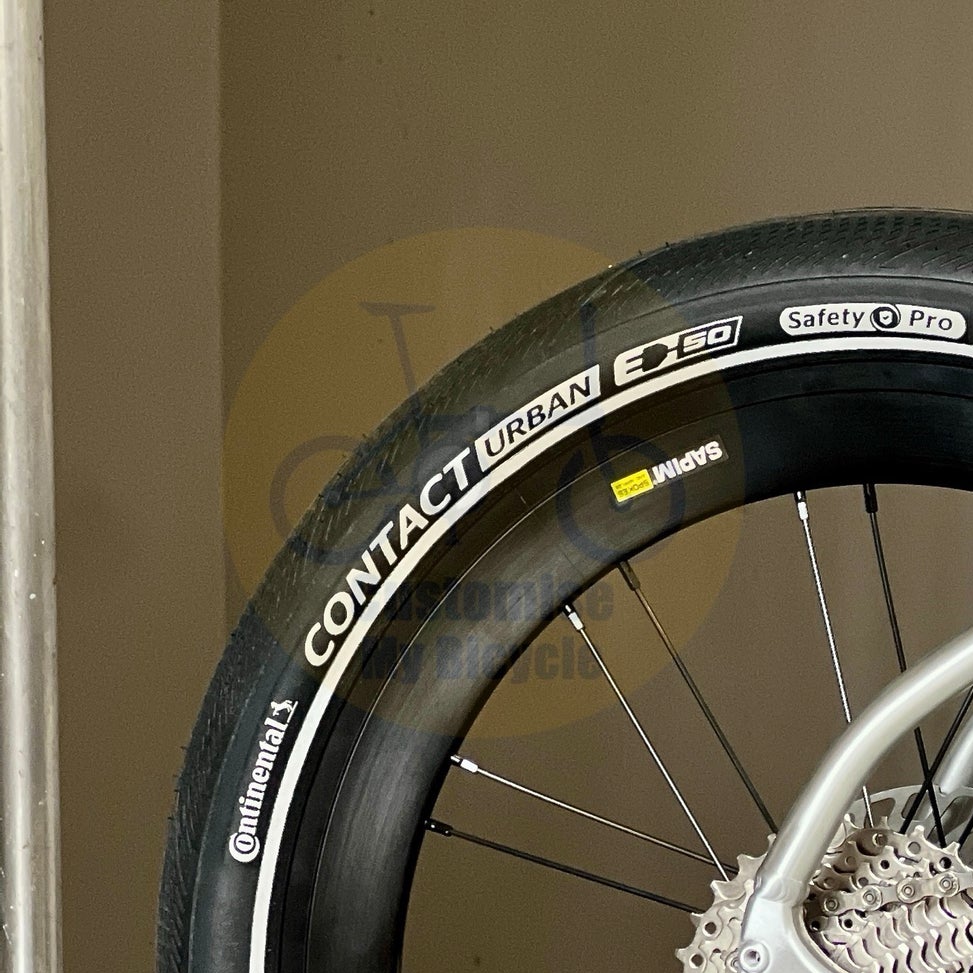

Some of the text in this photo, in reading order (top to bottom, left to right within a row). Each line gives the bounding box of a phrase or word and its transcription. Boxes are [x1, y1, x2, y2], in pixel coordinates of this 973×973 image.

[788, 309, 953, 331] Safety Pro
[652, 441, 723, 484] SAPIM
[304, 447, 470, 667] CONTACT
[484, 375, 591, 459] URBAN
[228, 717, 289, 863] Continental
